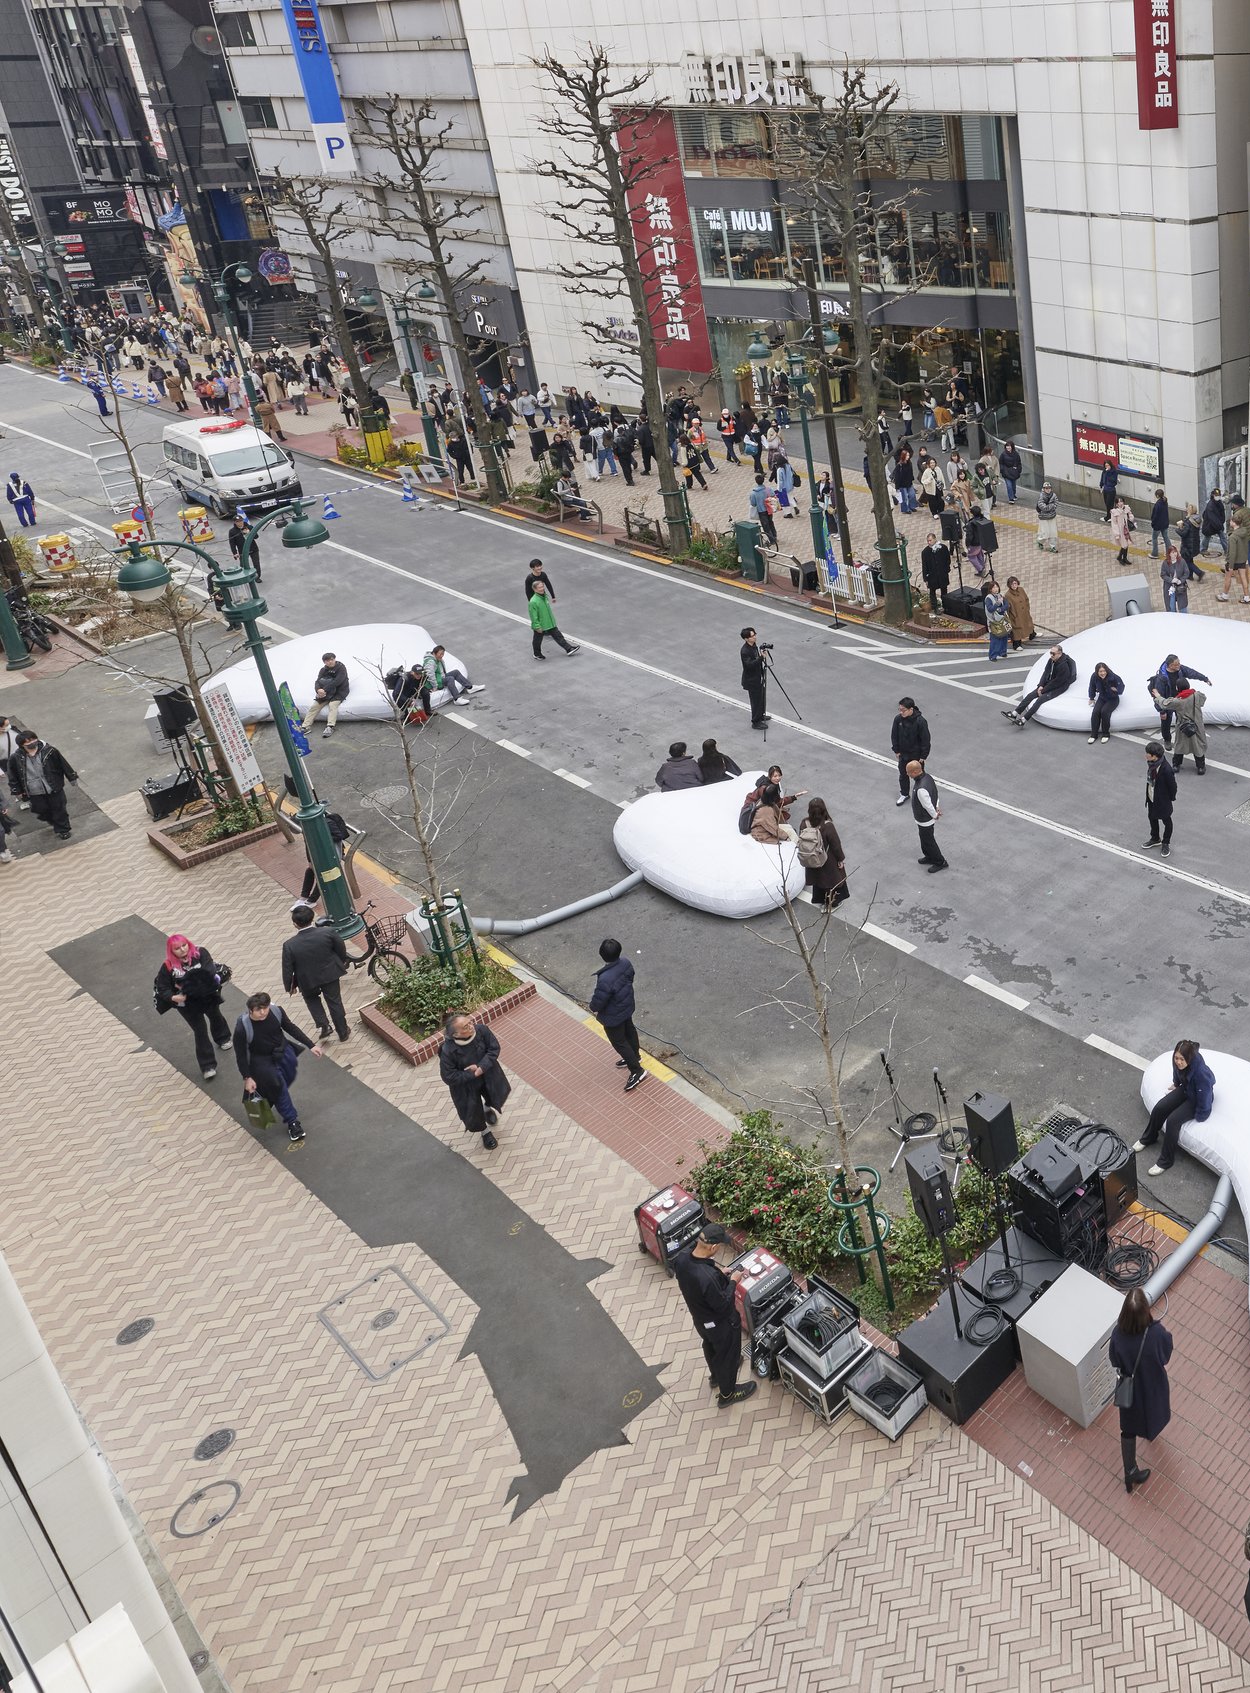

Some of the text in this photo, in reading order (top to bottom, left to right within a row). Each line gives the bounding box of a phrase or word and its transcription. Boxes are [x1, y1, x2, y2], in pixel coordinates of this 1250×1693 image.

[680, 50, 806, 106] 無印良品
[325, 137, 345, 160] P
[1, 176, 24, 200] DO
[10, 202, 31, 221] IT.
[65, 201, 78, 209] 8F
[93, 200, 111, 208] MO
[96, 209, 114, 217] MO
[703, 210, 721, 220] Café
[730, 210, 773, 232] MUJI
[709, 220, 728, 230] Mel
[645, 193, 691, 341] 無印良品
[474, 311, 498, 336] P OUT
[1079, 437, 1117, 458] 無印良品
[670, 1208, 692, 1226] HONDA
[758, 1275, 781, 1294] HONDA
